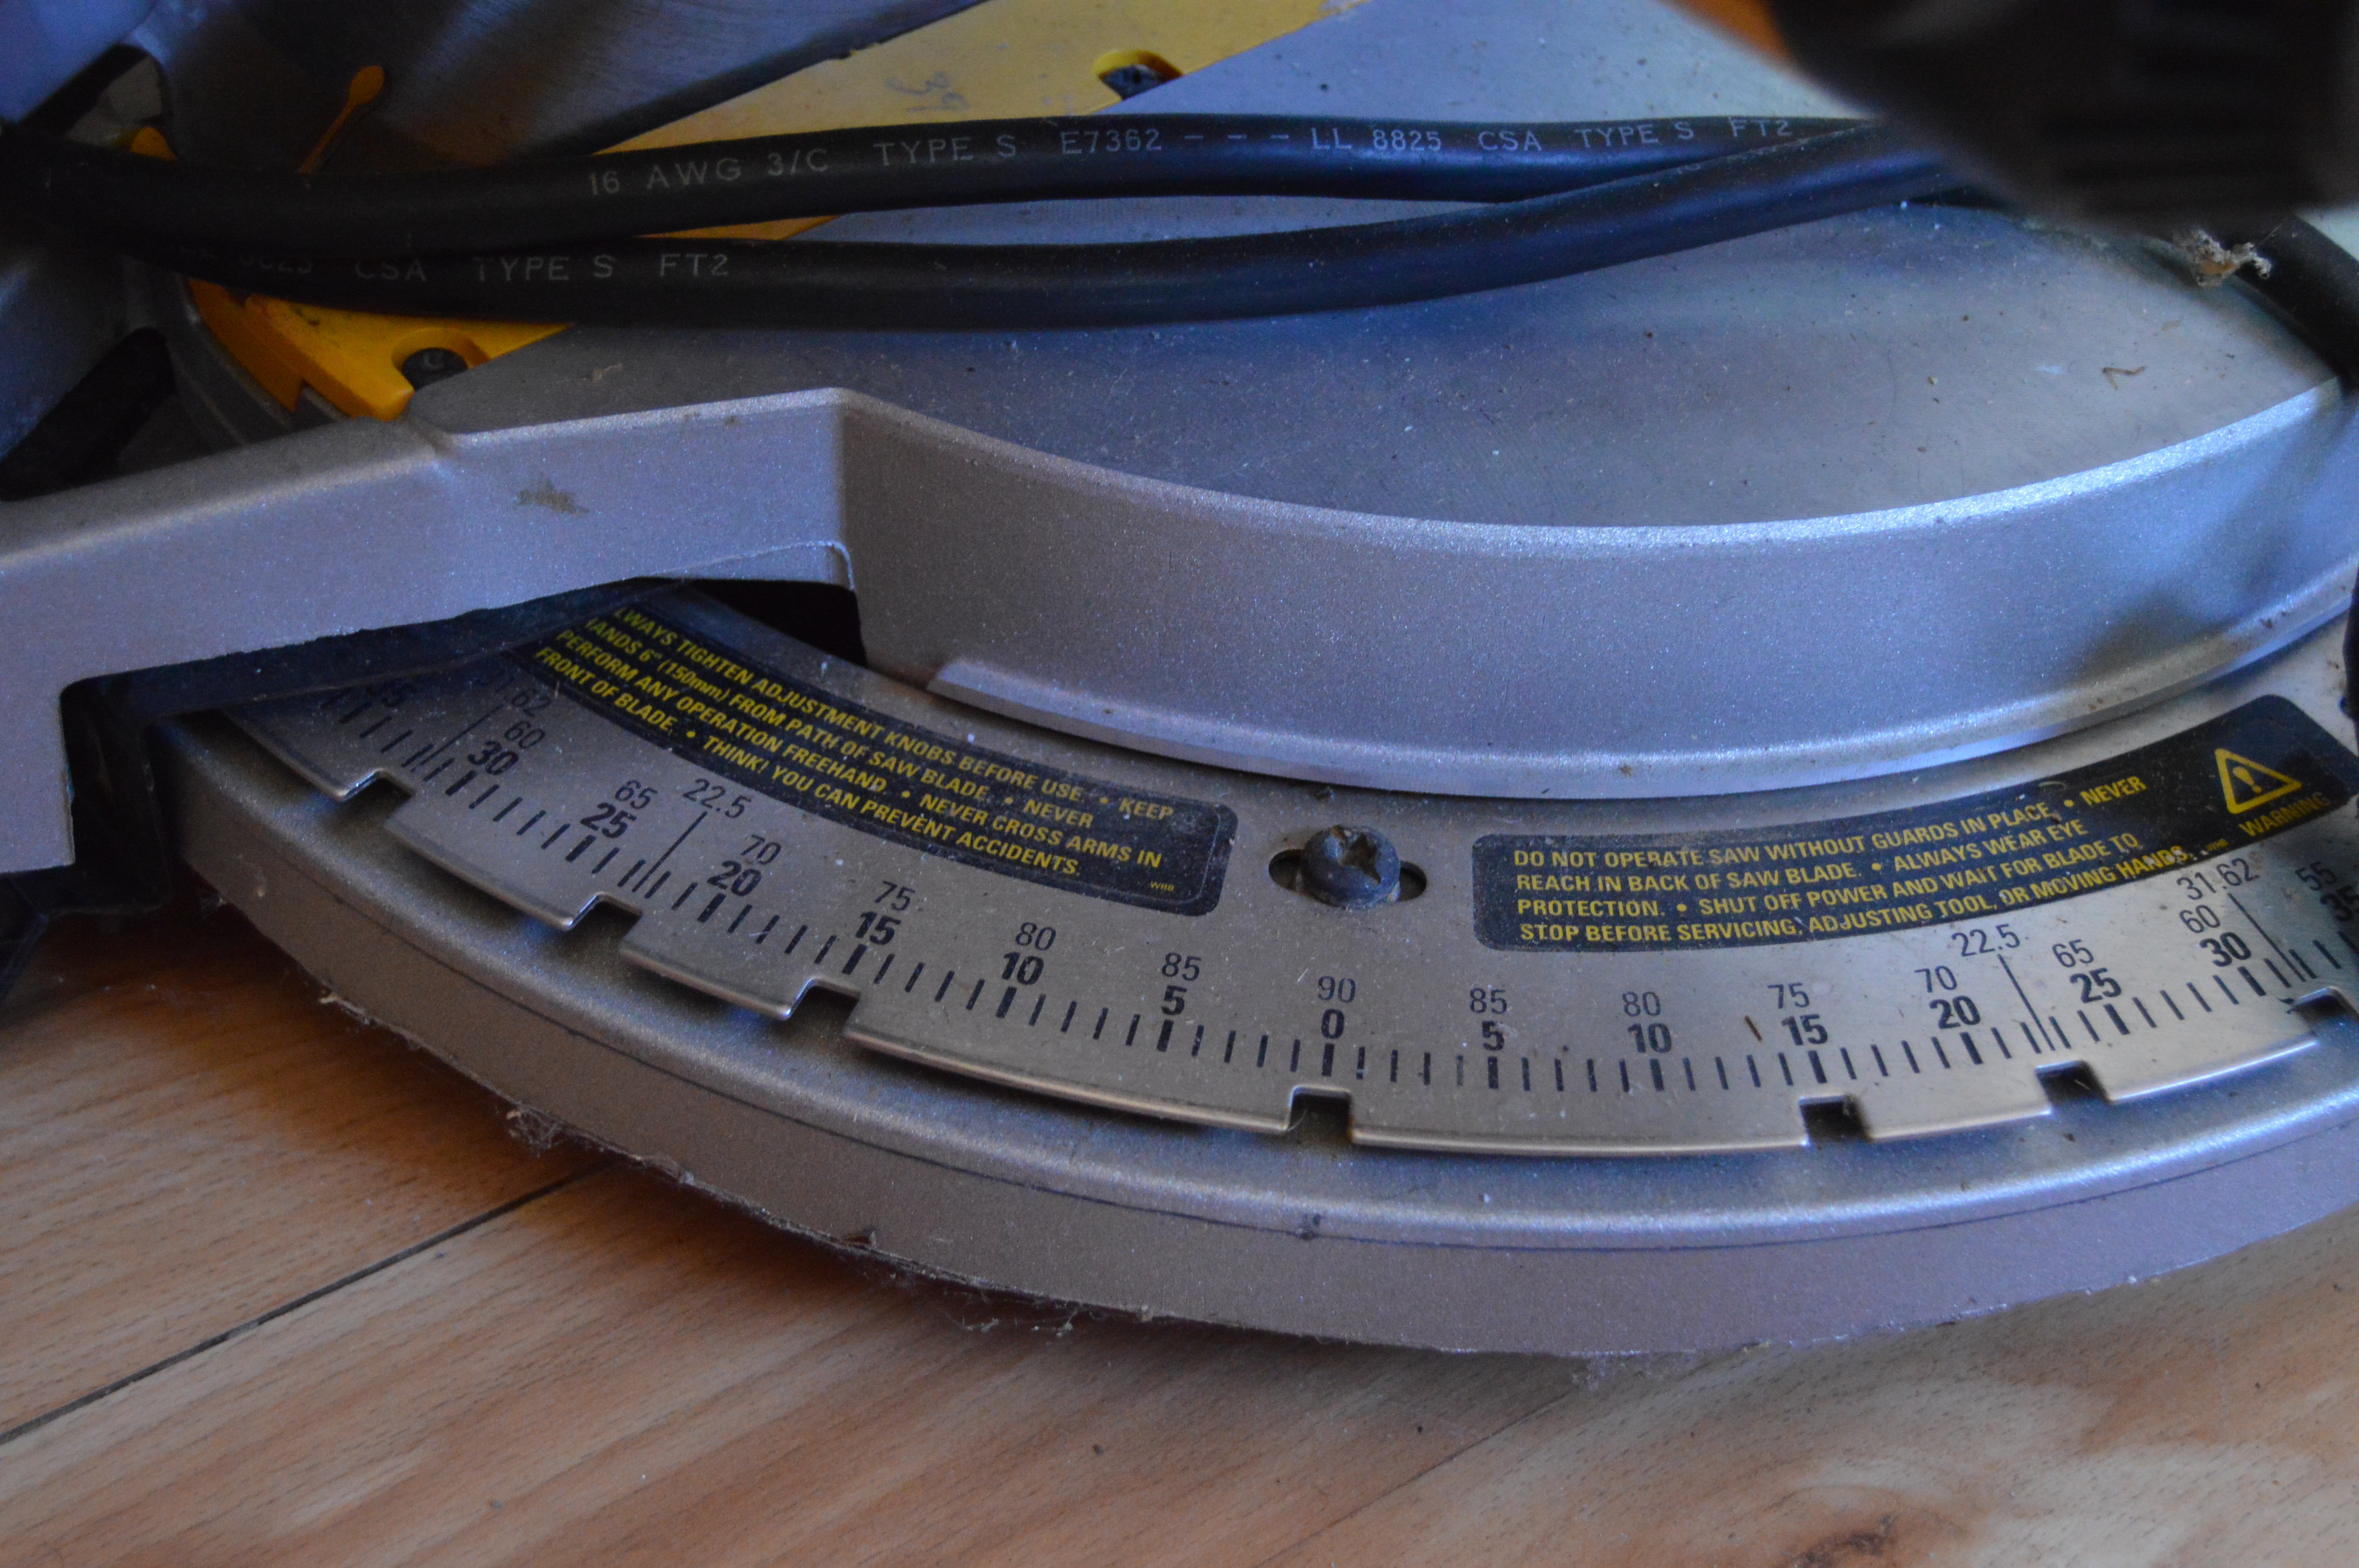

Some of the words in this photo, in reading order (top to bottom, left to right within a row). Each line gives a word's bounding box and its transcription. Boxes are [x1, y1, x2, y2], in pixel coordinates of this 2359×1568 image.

[588, 171, 621, 196] 16
[645, 157, 743, 191] AWG
[767, 147, 829, 178] 3/C
[874, 136, 972, 167] TYPE
[995, 133, 1018, 158] S
[1059, 127, 1162, 156] E7362
[1310, 127, 1353, 151] LL
[1372, 129, 1441, 153] 8825
[1478, 129, 1543, 152] CSA
[1574, 123, 1659, 149] TYPE
[1674, 121, 1695, 140] S
[1728, 115, 1793, 138] FT2
[354, 258, 427, 283] CSA
[472, 255, 571, 284] TYPE
[592, 253, 614, 278] S
[659, 252, 730, 278] FT2
[614, 605, 679, 647] LWAYS
[678, 641, 754, 685] TIGHTEN
[751, 678, 885, 738] ADJUSTMENT
[885, 732, 955, 765] KNOBS
[959, 757, 1038, 789] BEFORE
[1119, 798, 1174, 819] KEEP
[503, 720, 547, 750] 60
[557, 629, 640, 683] PERFORM
[634, 675, 680, 702] ANY
[676, 695, 783, 753] OPERATION
[920, 793, 989, 826] NEVER
[992, 817, 1063, 845] CROSS
[1067, 836, 1132, 862] ARMS
[1137, 850, 1162, 869] IN
[658, 661, 732, 702] (150mm)
[729, 693, 787, 727] FROM
[785, 717, 840, 750] PATH
[841, 740, 871, 759] OF
[868, 751, 919, 777] SAW
[1023, 799, 1095, 828] NEVER
[466, 739, 521, 776] 30
[536, 648, 596, 684] FRONT
[591, 680, 620, 698] OF
[614, 692, 678, 735] BLADE.
[703, 735, 769, 771] THINK!
[772, 765, 814, 791] YOU
[815, 784, 861, 810] CAN
[860, 799, 956, 840] PREVENT
[956, 831, 1080, 876] ACCIDENTS.
[614, 779, 660, 810] 65
[682, 778, 753, 818] 22.5
[579, 801, 638, 839] 25
[1514, 850, 1545, 866] DO
[1552, 851, 1595, 867] NOT
[1605, 851, 1703, 868] OPERATE
[1709, 846, 1760, 864] SAW
[1766, 836, 1865, 860] WITHOUT
[1872, 823, 1959, 848] GUARDS
[1961, 818, 1986, 833] IN
[2080, 775, 2148, 806] NEVER
[2238, 792, 2331, 837] WARNING
[740, 833, 783, 866] 70
[1518, 875, 1590, 891] REACH
[1598, 877, 1623, 891] IN
[1628, 876, 1688, 891] BACK
[1695, 873, 1721, 890] OF
[1727, 870, 1779, 887] SAW
[1786, 862, 1863, 884] BLADE.
[1895, 844, 1982, 871] ALWAYS
[1983, 829, 2048, 855] WEAR
[2046, 819, 2088, 841] EYE
[706, 860, 762, 898] 20
[1518, 898, 1666, 917] PROTECTION.
[1699, 896, 1756, 915] SHUT
[1764, 893, 1801, 910] OFF
[1807, 885, 1888, 906] POWER
[1893, 877, 1939, 897] AND
[1941, 867, 1997, 889] WAIT
[2001, 858, 2042, 877] FOR
[2043, 841, 2110, 869] BLADE
[2110, 833, 2139, 850] TO
[2177, 856, 2260, 902] 31.62
[2295, 861, 2337, 891] 55
[874, 880, 917, 912] 75
[1521, 924, 1580, 941] STOP
[1586, 925, 1671, 942] BEFORE
[1677, 919, 1803, 942] SERVICING,
[1809, 904, 1933, 931] ADJUSTING
[1936, 895, 1997, 916] TOOL,
[2002, 887, 2030, 904] OR
[2030, 866, 2118, 898] MOVING
[853, 911, 902, 946] 15
[1014, 921, 1056, 951] 80
[2178, 904, 2221, 936] 60
[1950, 922, 2022, 958] 22.5
[2051, 938, 2095, 970] 65
[2199, 930, 2253, 967] 30
[1000, 951, 1045, 986] 10
[1161, 952, 1203, 982] 85
[1914, 964, 1958, 994] 70
[1160, 985, 1187, 1018] 5
[1318, 975, 1358, 1004] 90
[1469, 987, 1508, 1014] 85
[1767, 982, 1810, 1010] 75
[2069, 966, 2123, 1004] 25
[1622, 990, 1663, 1018] 80
[1928, 995, 1982, 1031] 20
[1320, 1008, 1345, 1040] 0
[1481, 1020, 1505, 1052] 5
[1627, 1022, 1673, 1054] 10
[1780, 1013, 1829, 1047] 15
